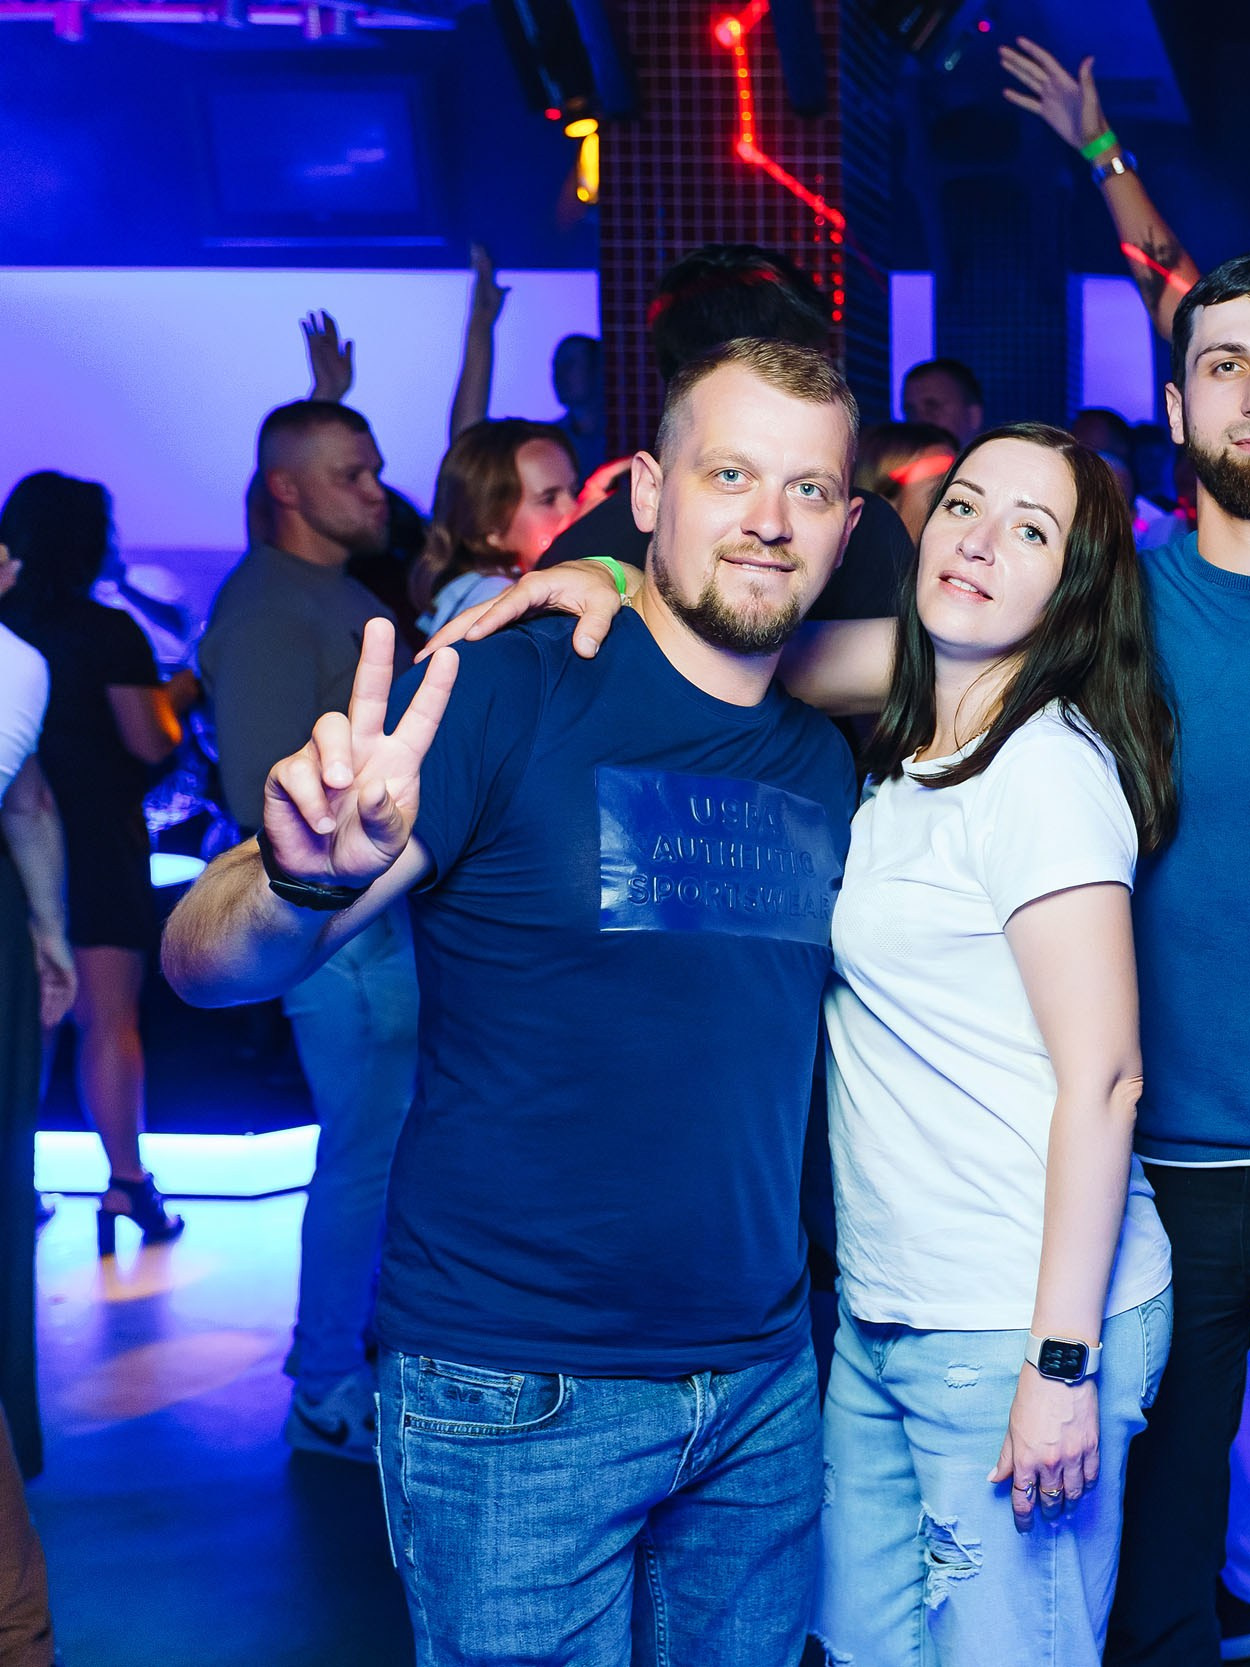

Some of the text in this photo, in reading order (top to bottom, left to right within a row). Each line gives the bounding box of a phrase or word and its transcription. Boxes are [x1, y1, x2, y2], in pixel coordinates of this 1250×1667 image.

[689, 797, 777, 833] USPA
[652, 834, 816, 877] AUTHENTIC
[627, 873, 832, 920] SPORTSWEAR
